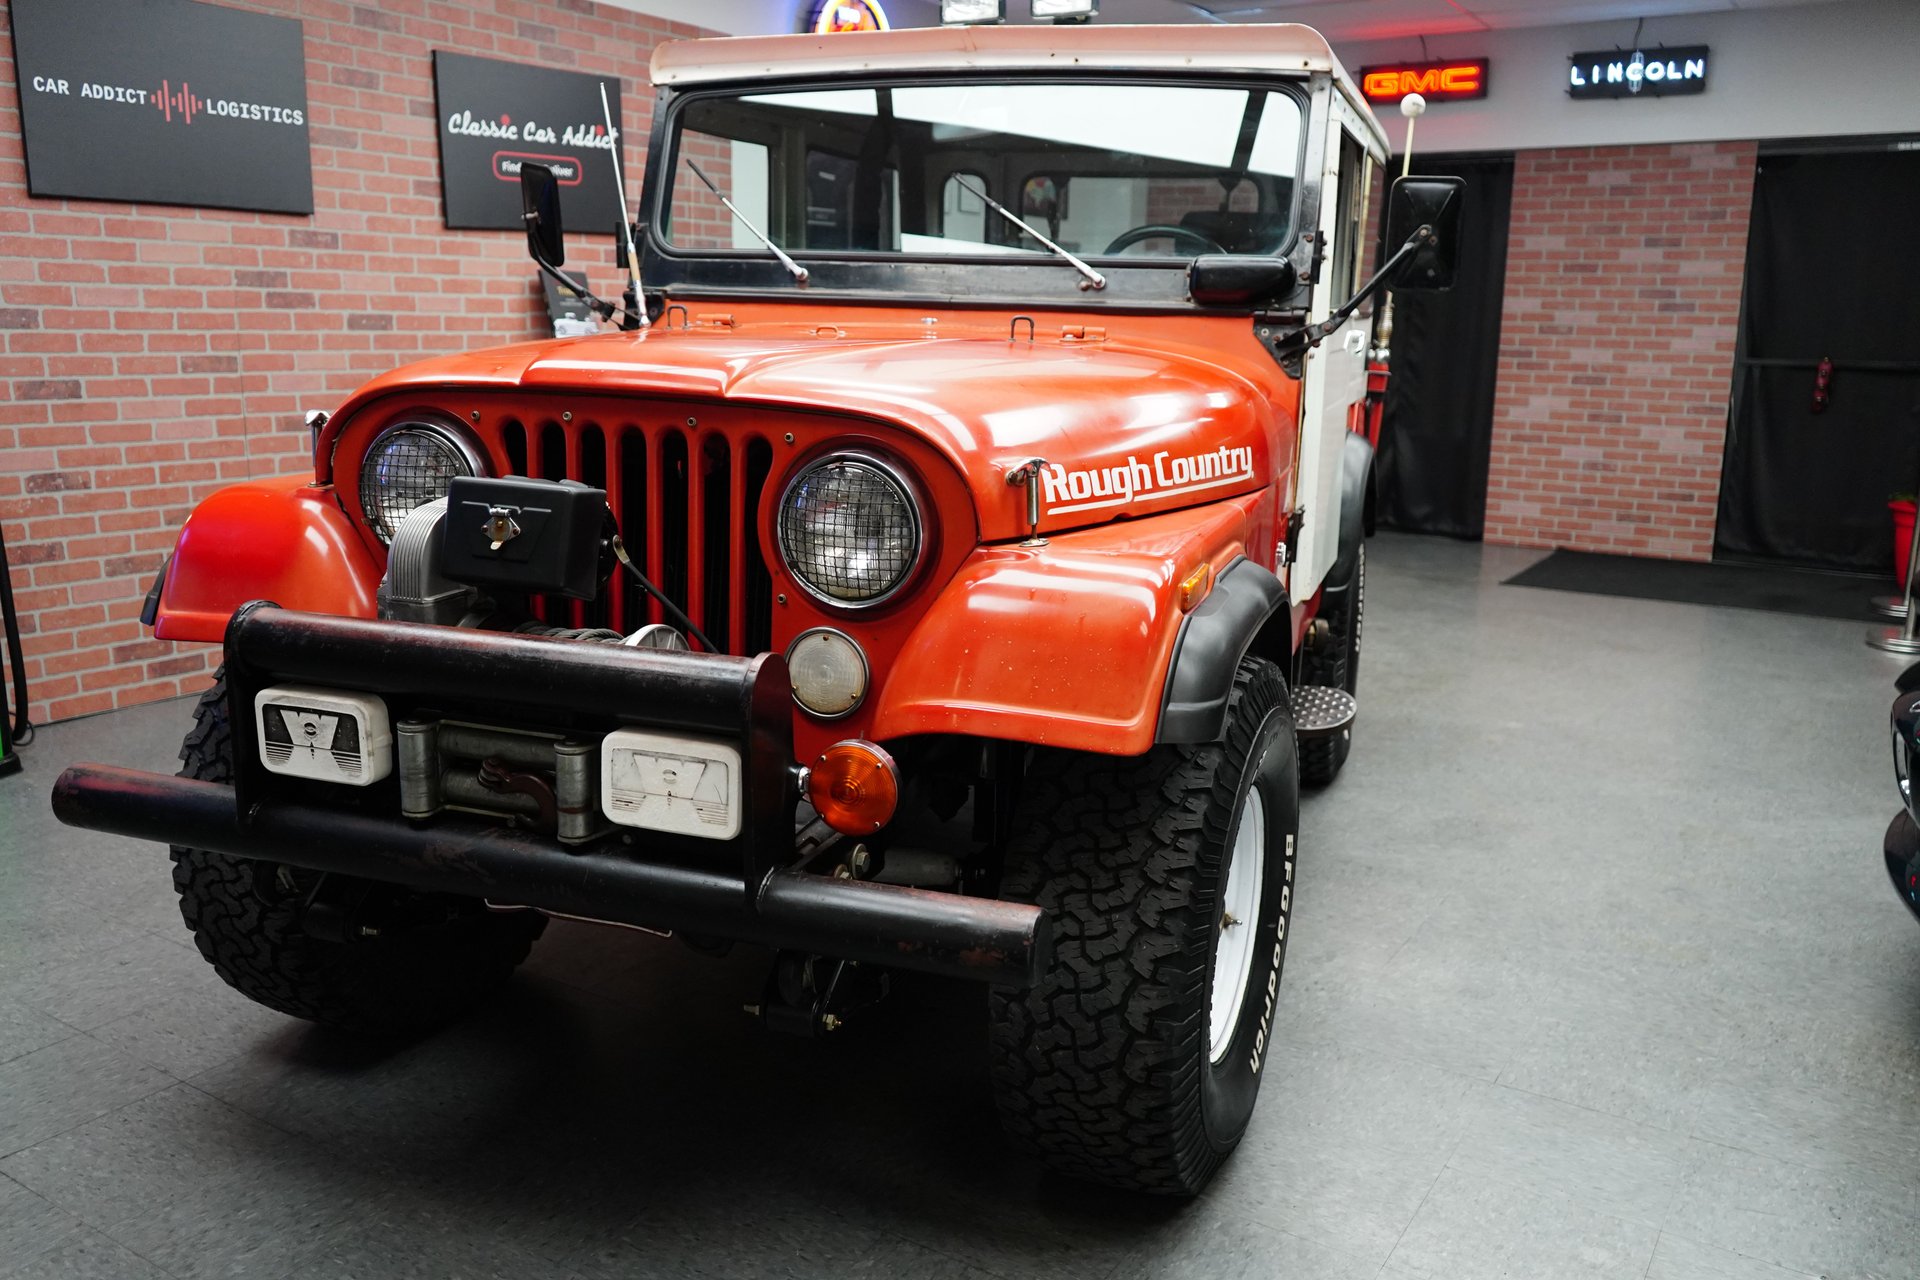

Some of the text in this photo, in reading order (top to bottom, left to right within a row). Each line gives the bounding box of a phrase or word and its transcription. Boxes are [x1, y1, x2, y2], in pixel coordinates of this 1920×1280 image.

[1363, 66, 1480, 97] GMC
[1570, 58, 1705, 86] LINCOLN
[33, 76, 304, 126] CAR ADDICT LOGISTICS
[448, 109, 620, 149] Classic Car Addict
[1041, 445, 1255, 503] Rough Country
[1250, 833, 1295, 1075] BFGoodrich
